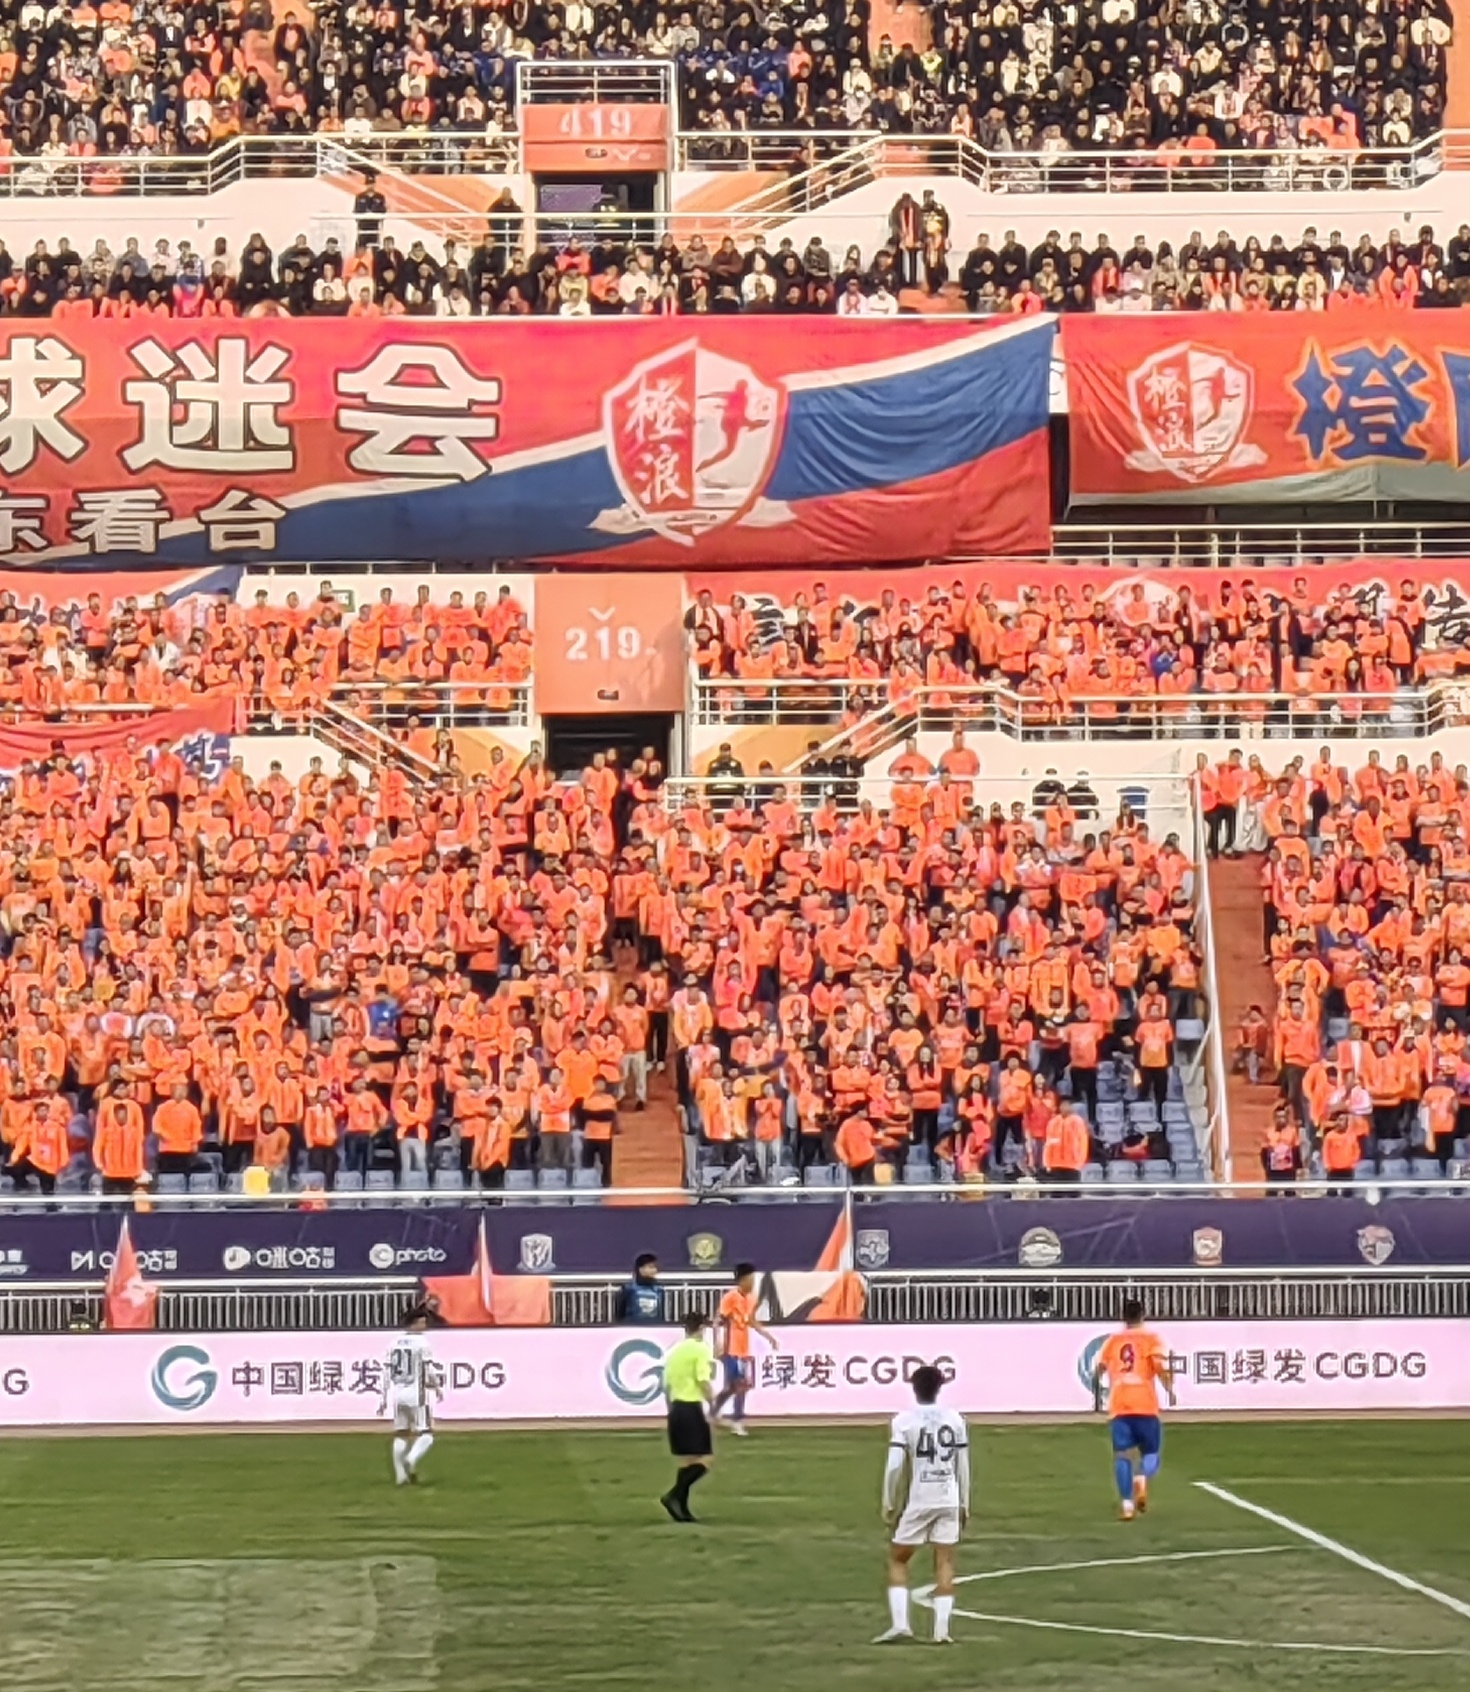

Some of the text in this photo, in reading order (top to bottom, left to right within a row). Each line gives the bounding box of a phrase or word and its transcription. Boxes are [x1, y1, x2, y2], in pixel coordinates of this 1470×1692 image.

[560, 107, 632, 138] 419
[624, 374, 691, 505] 橙浪
[565, 626, 641, 661] 219
[843, 1355, 956, 1385] CGDG
[1120, 1343, 1135, 1373] 9
[1315, 1352, 1427, 1378] CGDG
[231, 1359, 384, 1397] 中国绿发
[916, 1424, 956, 1465] 49
